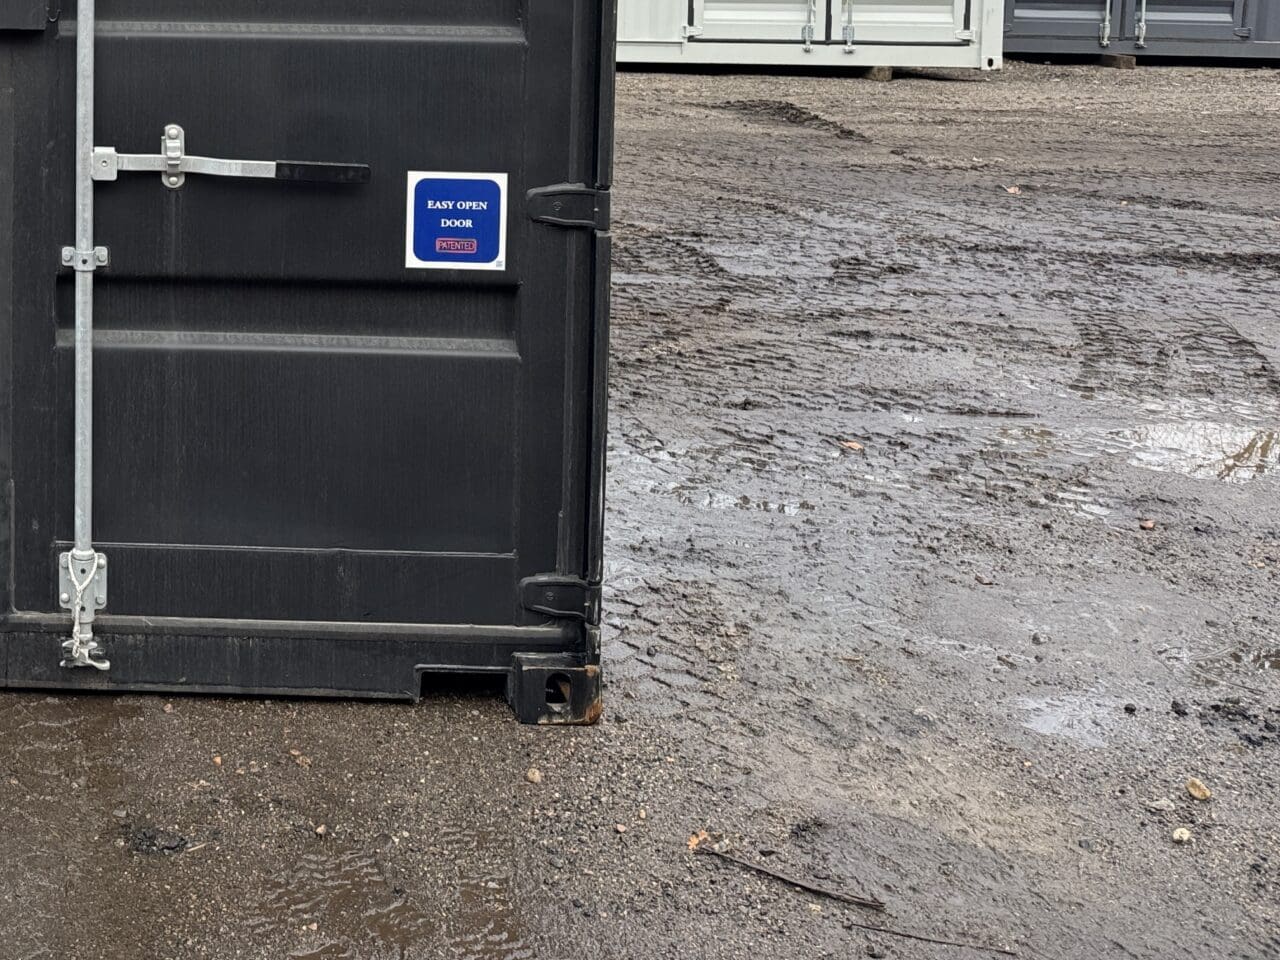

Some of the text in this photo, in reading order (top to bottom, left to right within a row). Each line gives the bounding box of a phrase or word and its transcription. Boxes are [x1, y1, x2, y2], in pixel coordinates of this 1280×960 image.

[426, 200, 488, 210] EASY OPEN
[440, 219, 473, 228] DOOR
[438, 241, 475, 250] PATENTED
